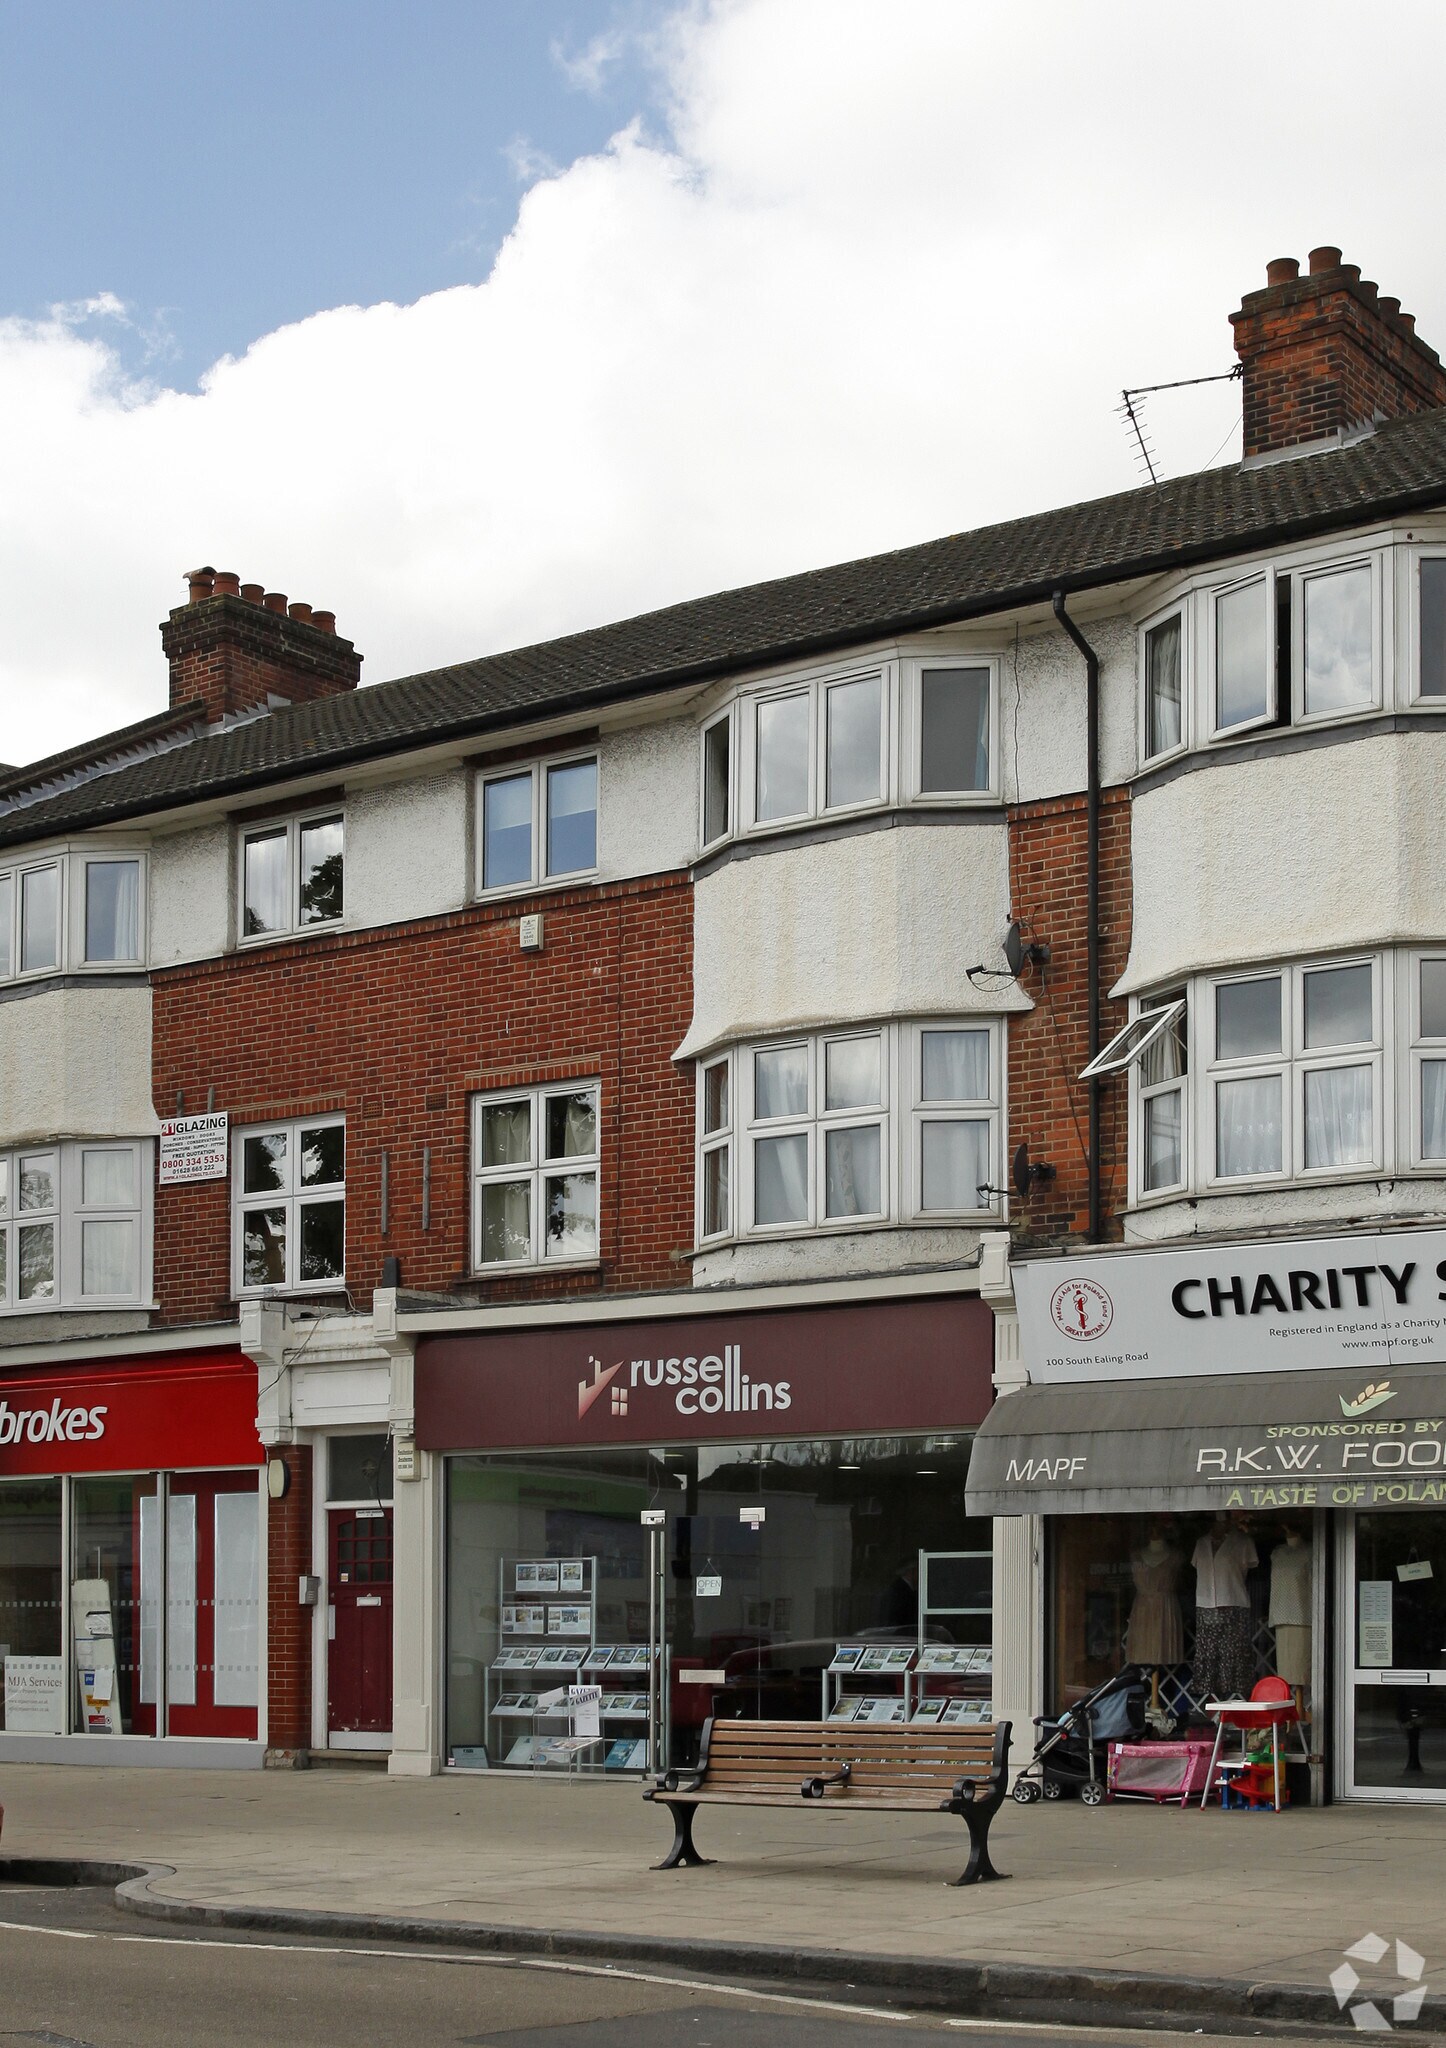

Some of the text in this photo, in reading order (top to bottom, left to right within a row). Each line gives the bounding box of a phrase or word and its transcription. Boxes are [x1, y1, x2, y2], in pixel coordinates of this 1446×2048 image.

[176, 1117, 226, 1133] GLAZING
[162, 1146, 191, 1154] MANUFACTURE
[186, 1149, 216, 1158] QUOTATION
[162, 1154, 225, 1169] 0800 334 5353
[1172, 1263, 1416, 1319] CHARITY
[1055, 1295, 1063, 1321] Medical
[1061, 1286, 1072, 1296] Aid
[1083, 1283, 1104, 1300] Poland
[1065, 1322, 1105, 1337] GREAT BRITAIN
[1269, 1325, 1322, 1338] Registered
[1325, 1325, 1335, 1333] in
[1337, 1322, 1378, 1334] England
[1381, 1321, 1392, 1329] as
[1403, 1318, 1440, 1329] Charity
[1341, 1336, 1434, 1349] www.mapf.org.uk
[631, 1345, 741, 1387] russell
[1046, 1352, 1149, 1366] 100 South Ealing Road
[675, 1372, 792, 1414] collins
[1266, 1421, 1444, 1438] SPONSORED BY
[1196, 1440, 1446, 1472] R.K.W. FOO
[1006, 1458, 1087, 1482] MAPF
[1225, 1489, 1244, 1506] A
[1250, 1486, 1318, 1506] TASTE
[1332, 1484, 1366, 1504] OF
[698, 1579, 721, 1588] OPEN
[8, 1676, 62, 1687] MJA Services
[575, 1691, 598, 1705] GAZETTE
